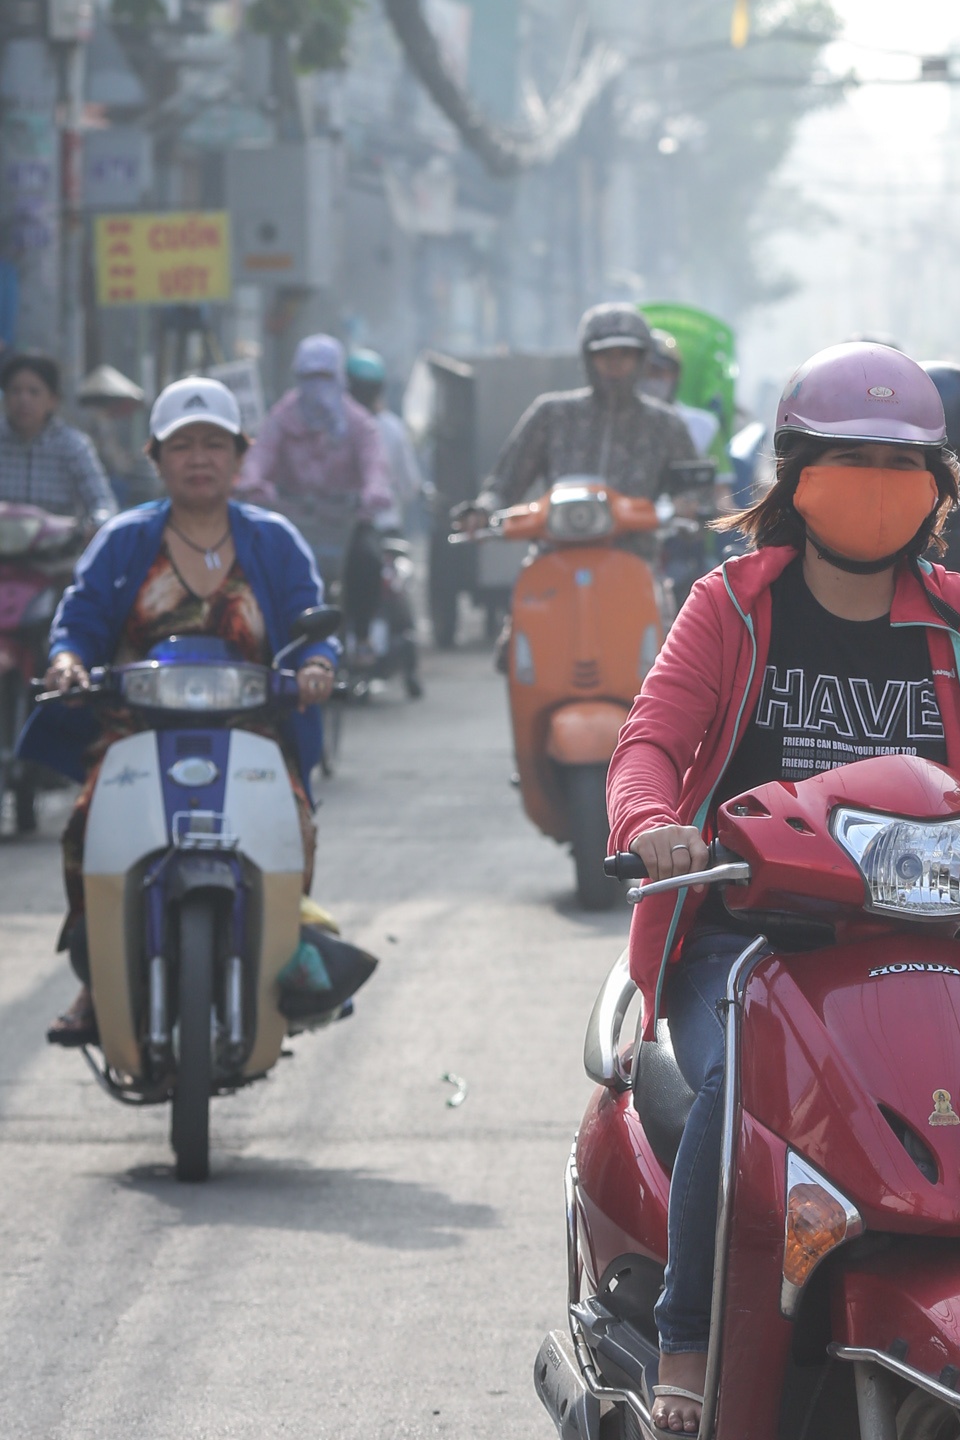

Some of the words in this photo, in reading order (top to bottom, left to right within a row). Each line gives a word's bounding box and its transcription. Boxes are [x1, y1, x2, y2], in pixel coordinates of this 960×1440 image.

[755, 665, 945, 741] HAVE
[783, 736, 815, 748] FRIENDS
[816, 738, 832, 750] CAN
[853, 745, 875, 756] YOUR
[875, 746, 900, 756] HEART
[901, 747, 917, 756] TOO
[781, 757, 814, 769] FRIENDS
[815, 760, 831, 770] CAN
